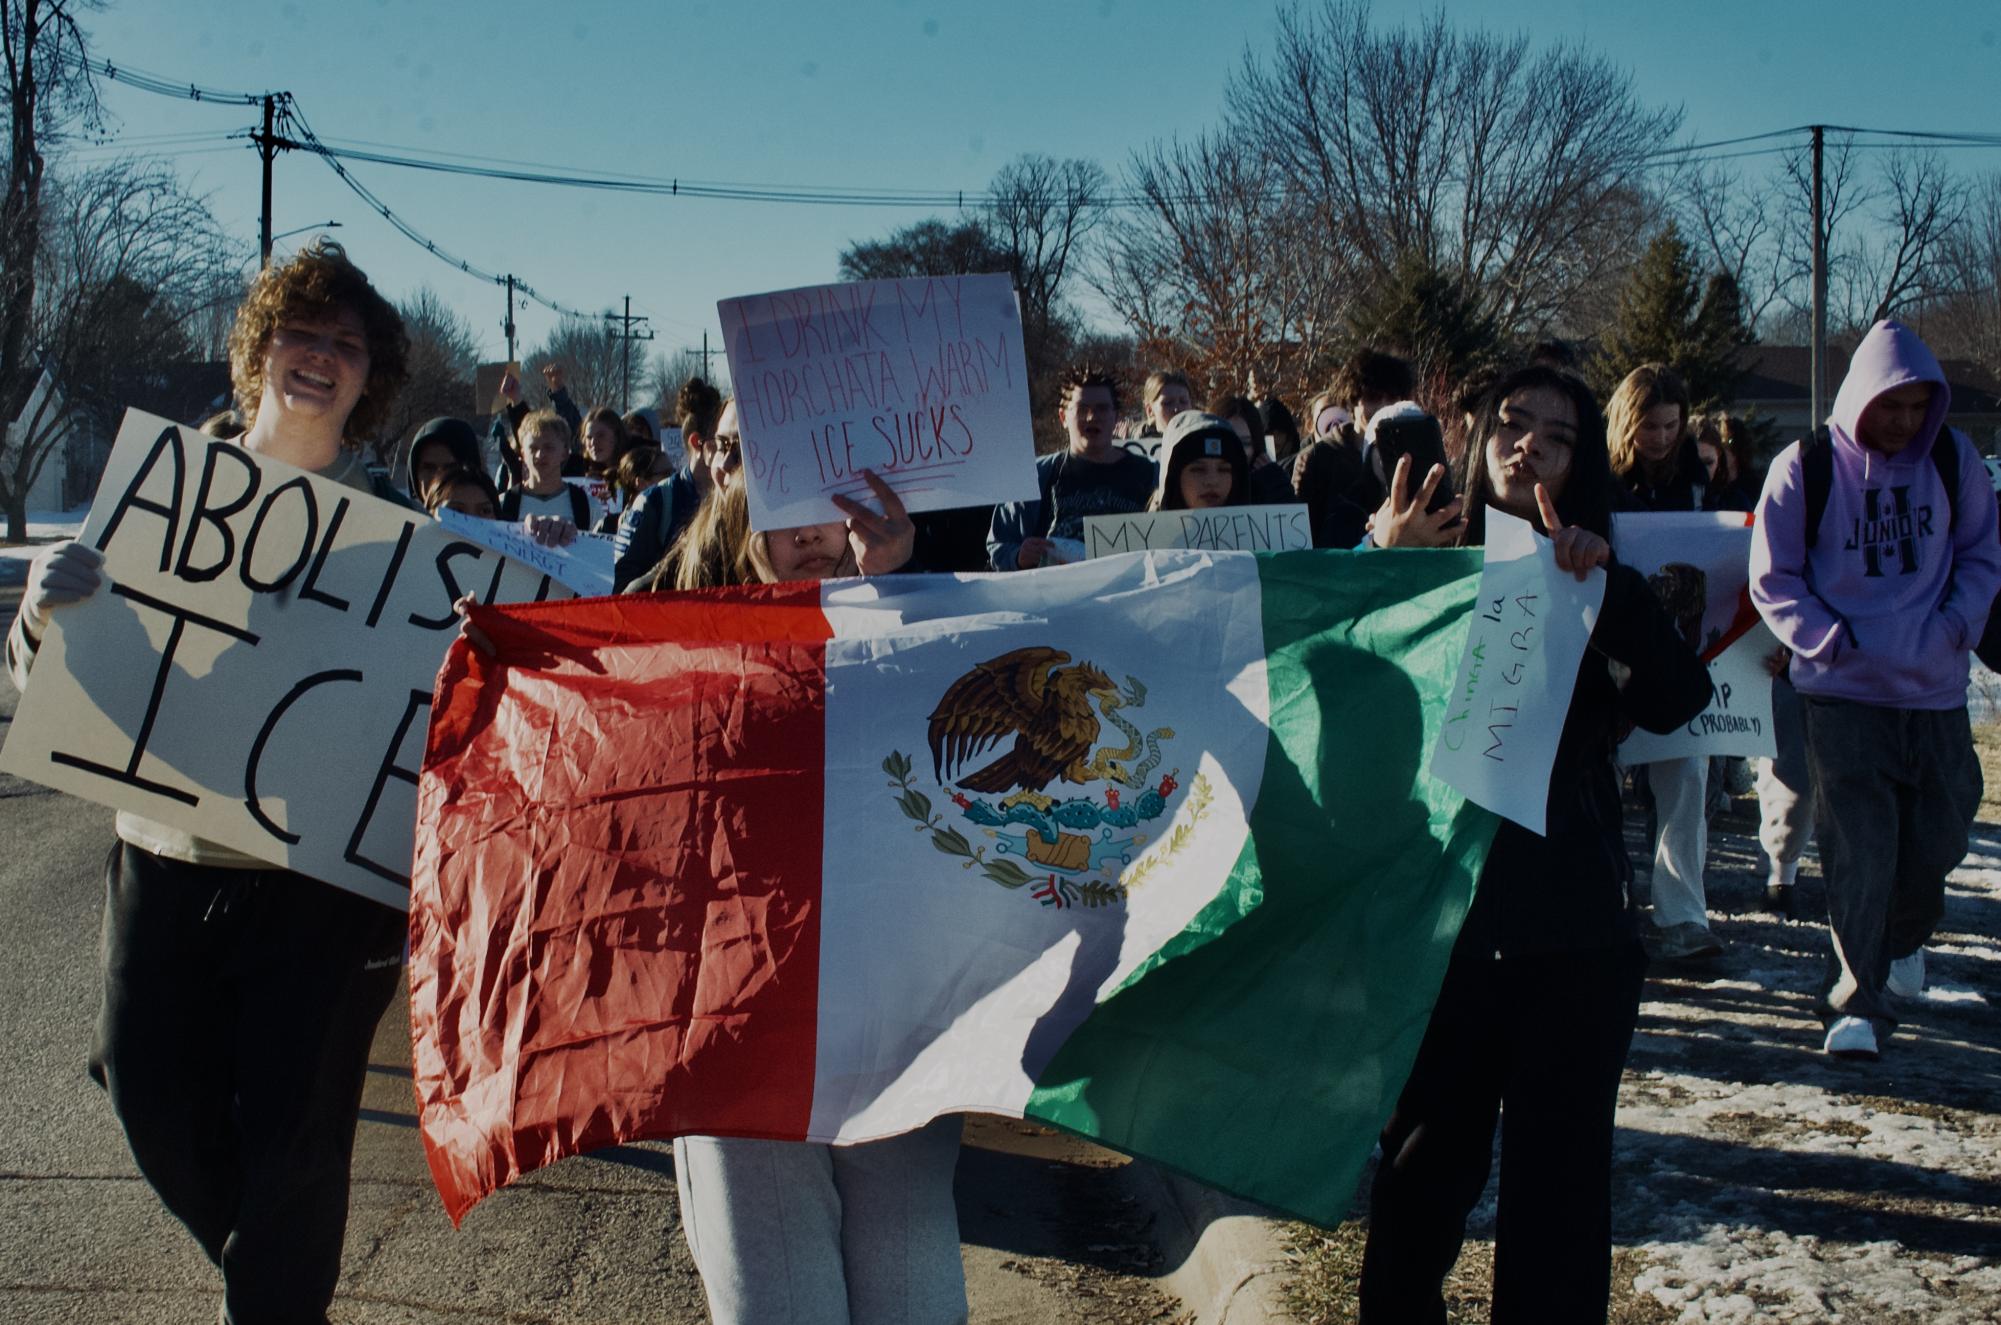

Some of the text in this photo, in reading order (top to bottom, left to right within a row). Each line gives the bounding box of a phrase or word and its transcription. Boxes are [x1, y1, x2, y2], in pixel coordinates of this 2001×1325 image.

[726, 277, 965, 365] I DRINK MY
[909, 331, 1012, 404] WARM
[811, 421, 865, 483] ICE
[872, 404, 973, 469] SUCKS
[1092, 519, 1155, 558] MY
[1180, 512, 1308, 550] PARENTS
[1844, 505, 1934, 550] JUNIOR
[1483, 590, 1538, 762] MIGRA
[51, 583, 434, 885] ICE
